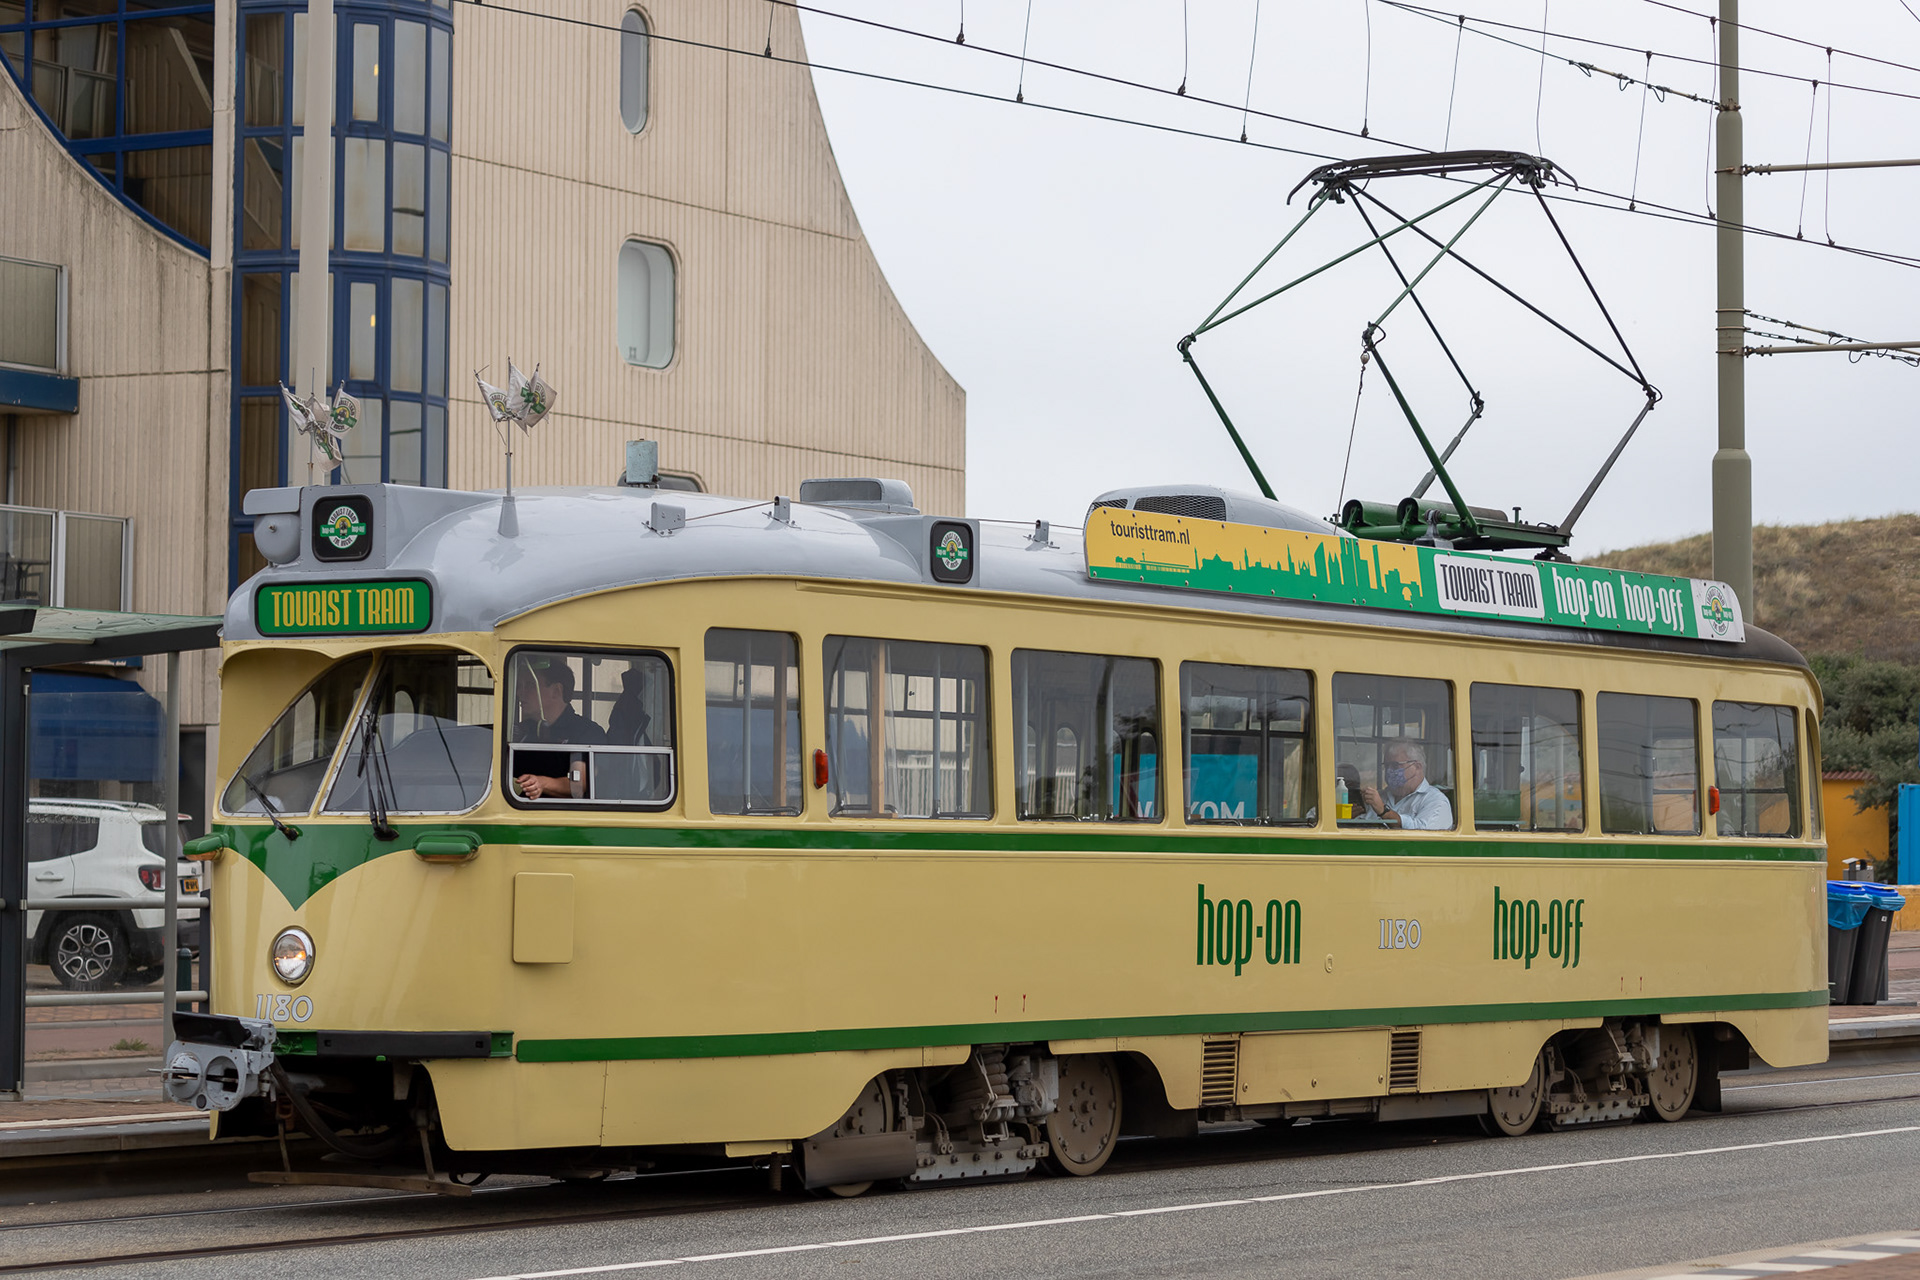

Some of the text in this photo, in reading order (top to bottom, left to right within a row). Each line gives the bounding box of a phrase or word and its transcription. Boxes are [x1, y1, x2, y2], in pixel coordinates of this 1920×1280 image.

[1110, 520, 1190, 545] touristtram.nl
[1440, 564, 1538, 609] TOURIST TRAM
[1551, 567, 1684, 632] hop-on hop-off
[271, 588, 415, 628] TOURIST TRAM
[1196, 883, 1302, 977] hop-on
[1378, 918, 1422, 950] 1180
[1493, 886, 1585, 970] hop-off
[255, 994, 314, 1023] 1180
